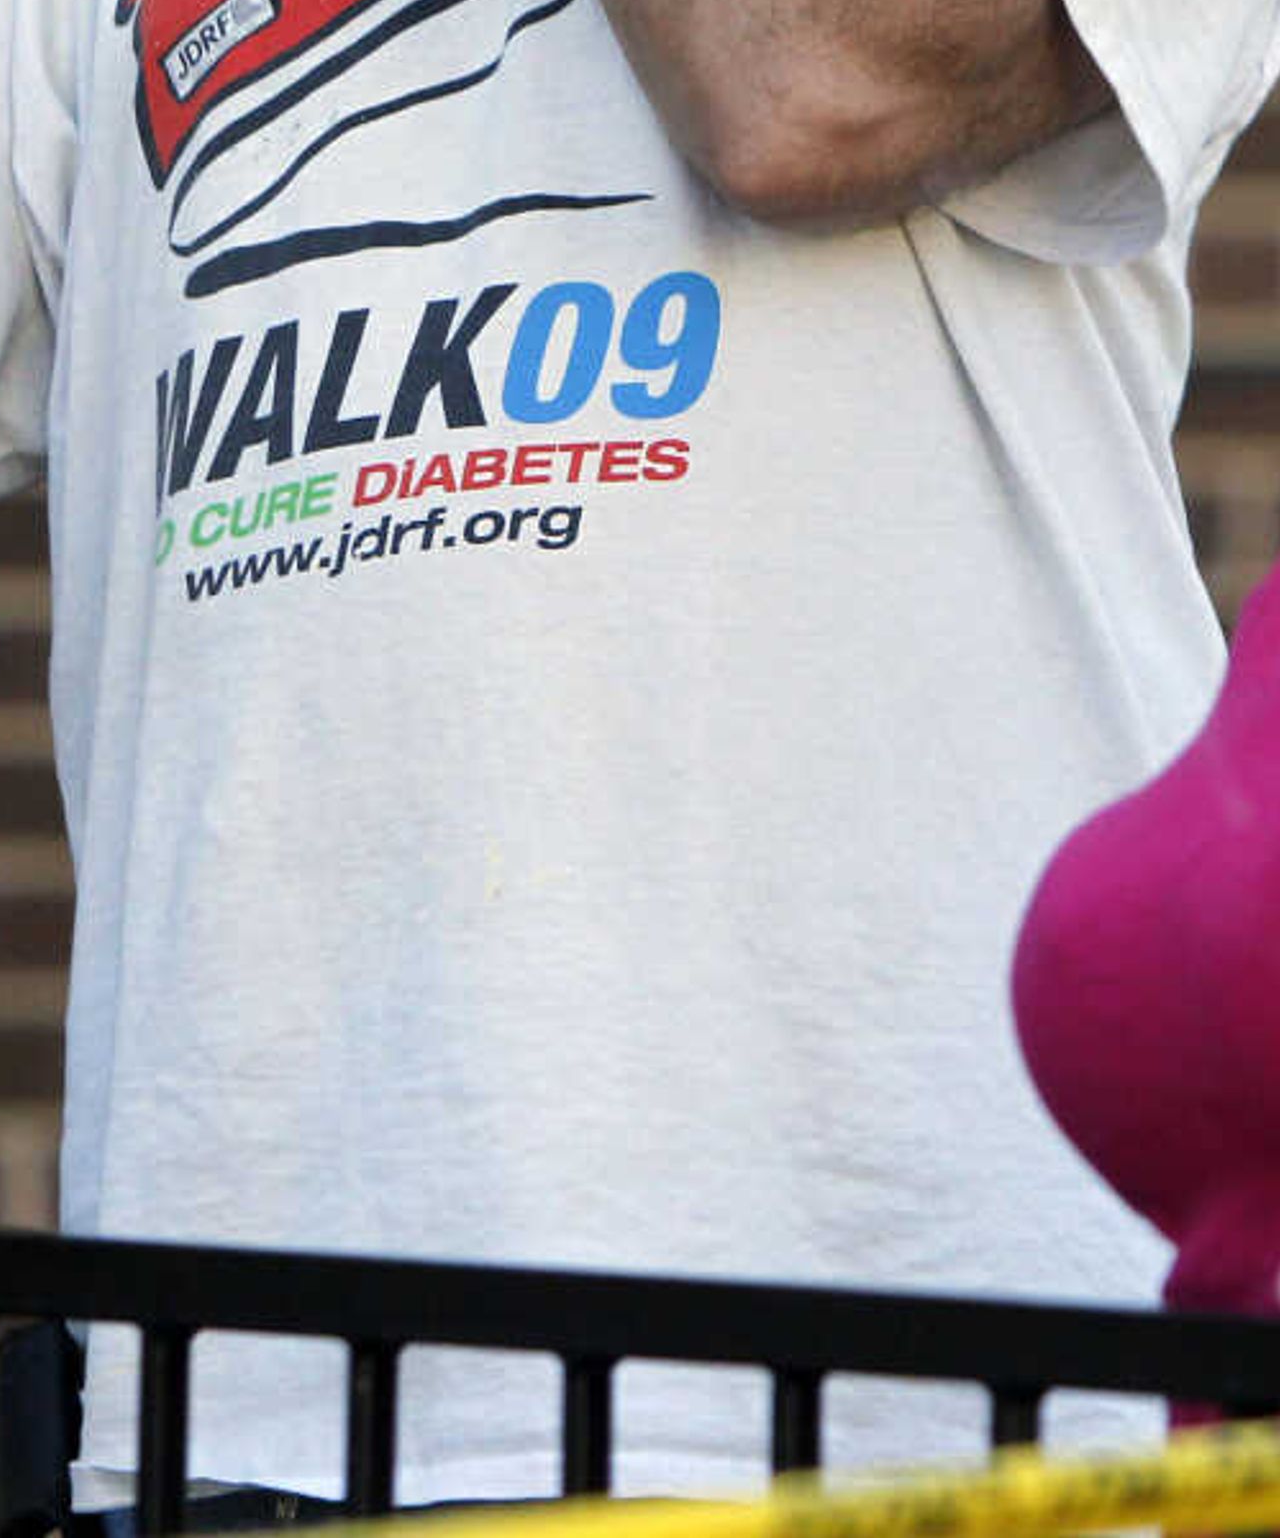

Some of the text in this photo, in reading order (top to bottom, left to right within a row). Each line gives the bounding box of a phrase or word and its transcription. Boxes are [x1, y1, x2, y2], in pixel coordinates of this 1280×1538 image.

[177, 9, 229, 79] JDRF
[185, 504, 583, 601] www.jdrf.org
[189, 473, 338, 558] CURE
